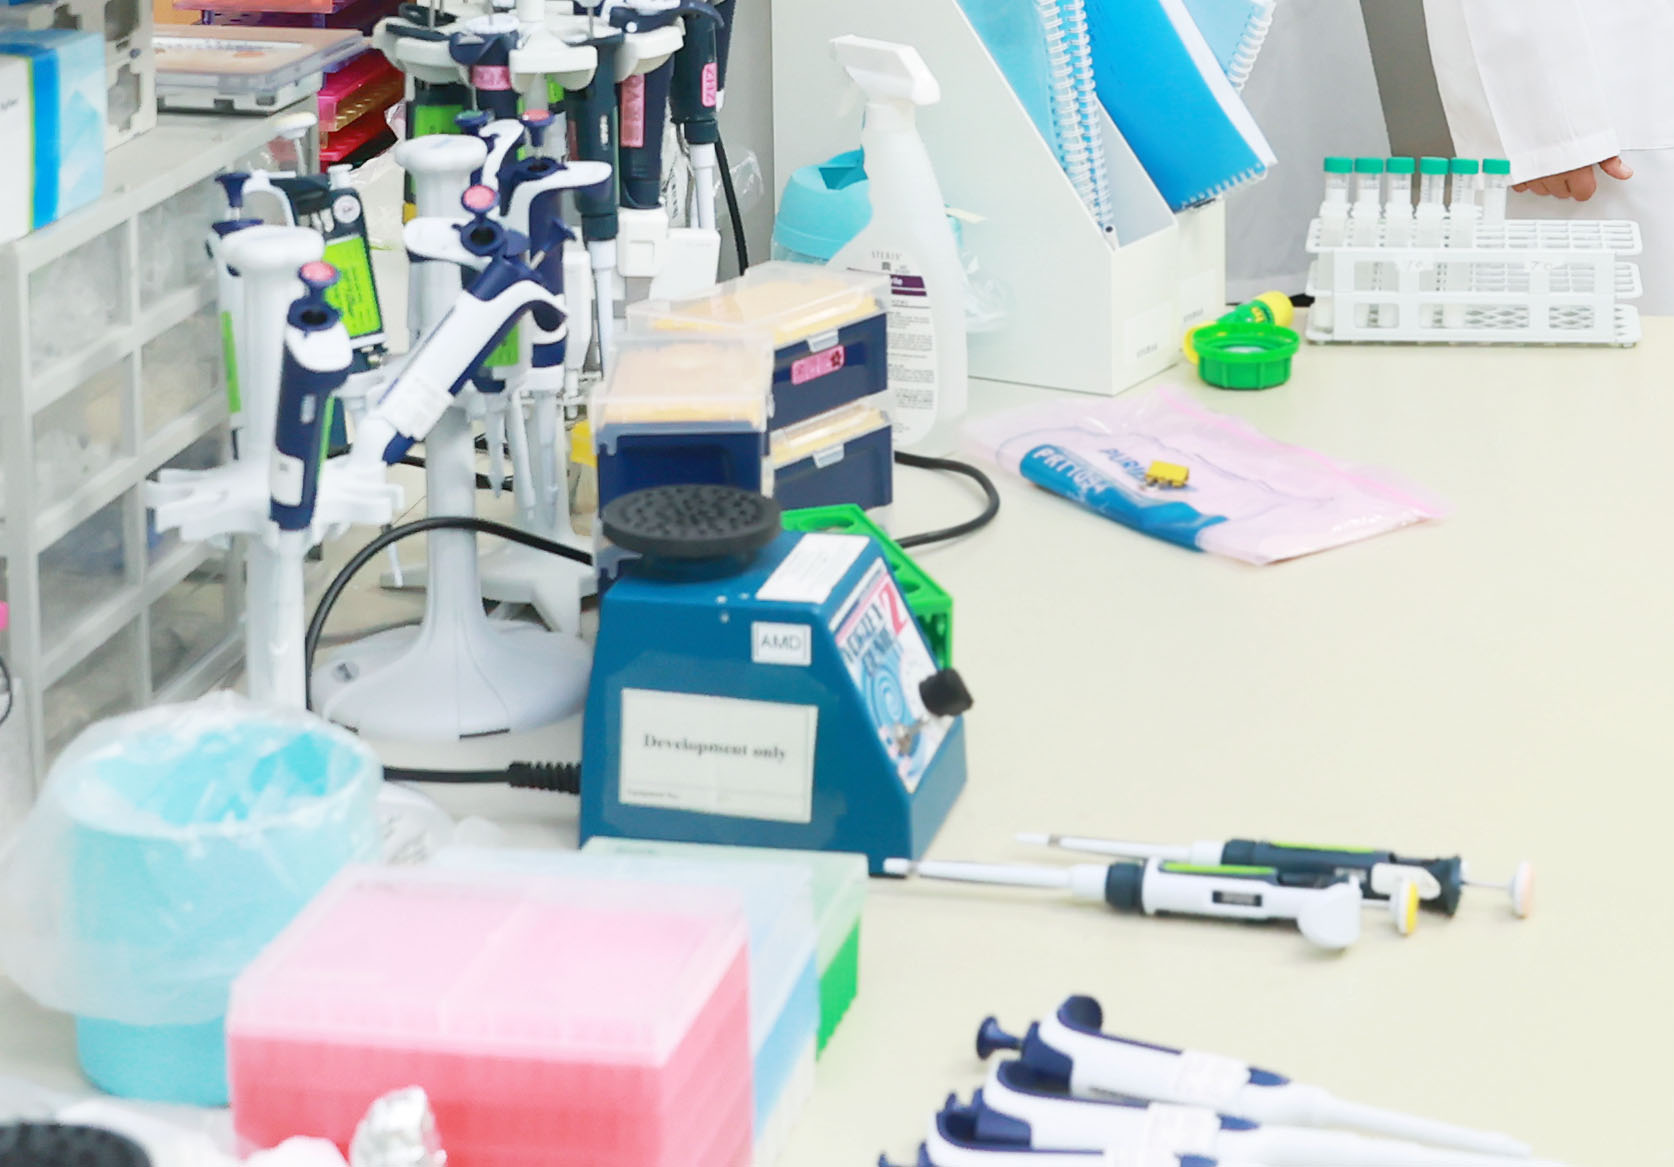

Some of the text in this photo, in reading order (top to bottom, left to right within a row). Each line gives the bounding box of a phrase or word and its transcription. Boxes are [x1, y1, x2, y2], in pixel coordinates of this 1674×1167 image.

[760, 634, 803, 652] AMD
[643, 733, 788, 762] Development only
